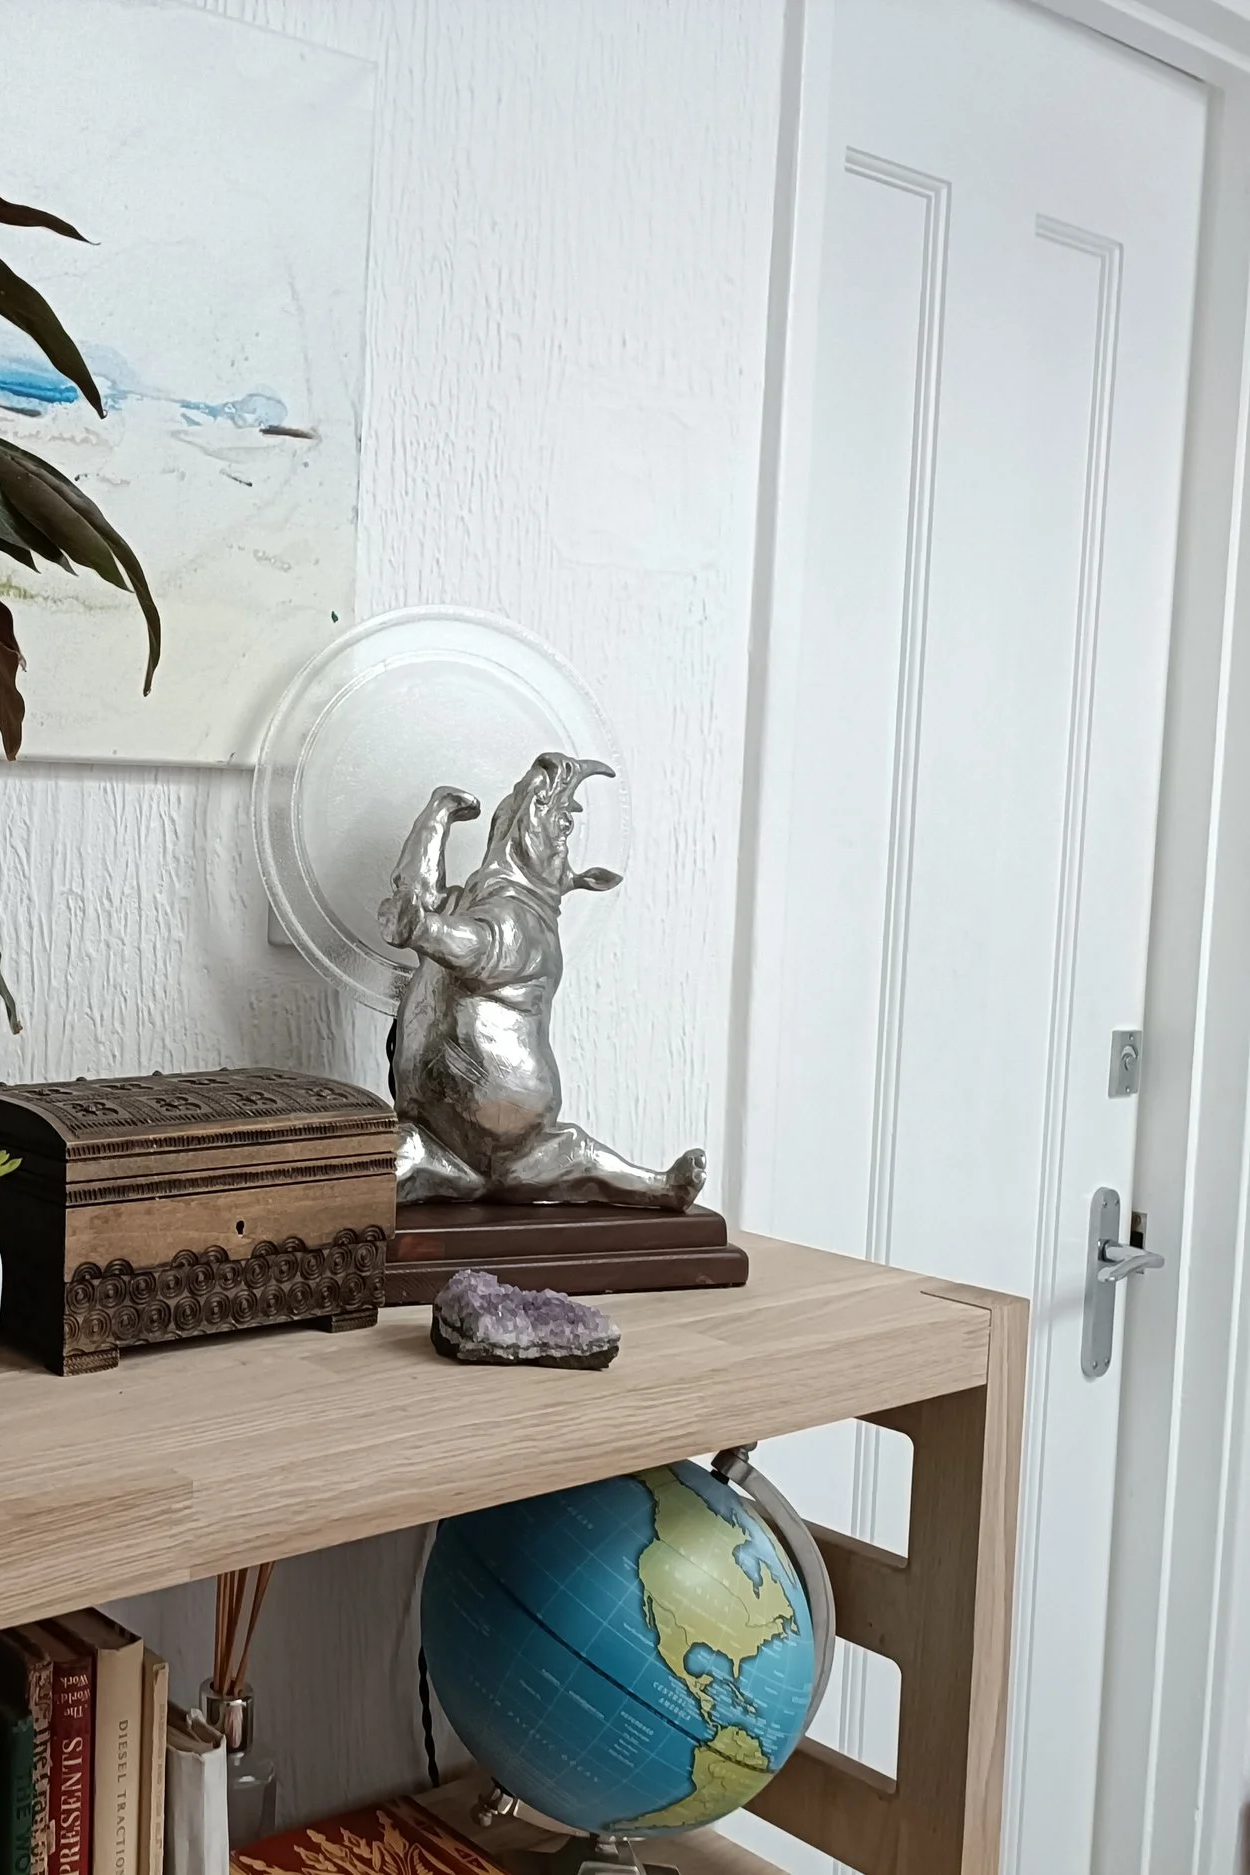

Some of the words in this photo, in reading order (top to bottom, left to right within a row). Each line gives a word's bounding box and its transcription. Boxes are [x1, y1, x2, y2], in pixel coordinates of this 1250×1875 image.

[60, 1674, 89, 1689] Work
[63, 1705, 85, 1719] The
[117, 1719, 129, 1783] DIESEL
[15, 1771, 31, 1820] THE
[59, 1736, 83, 1875] PRESENTS
